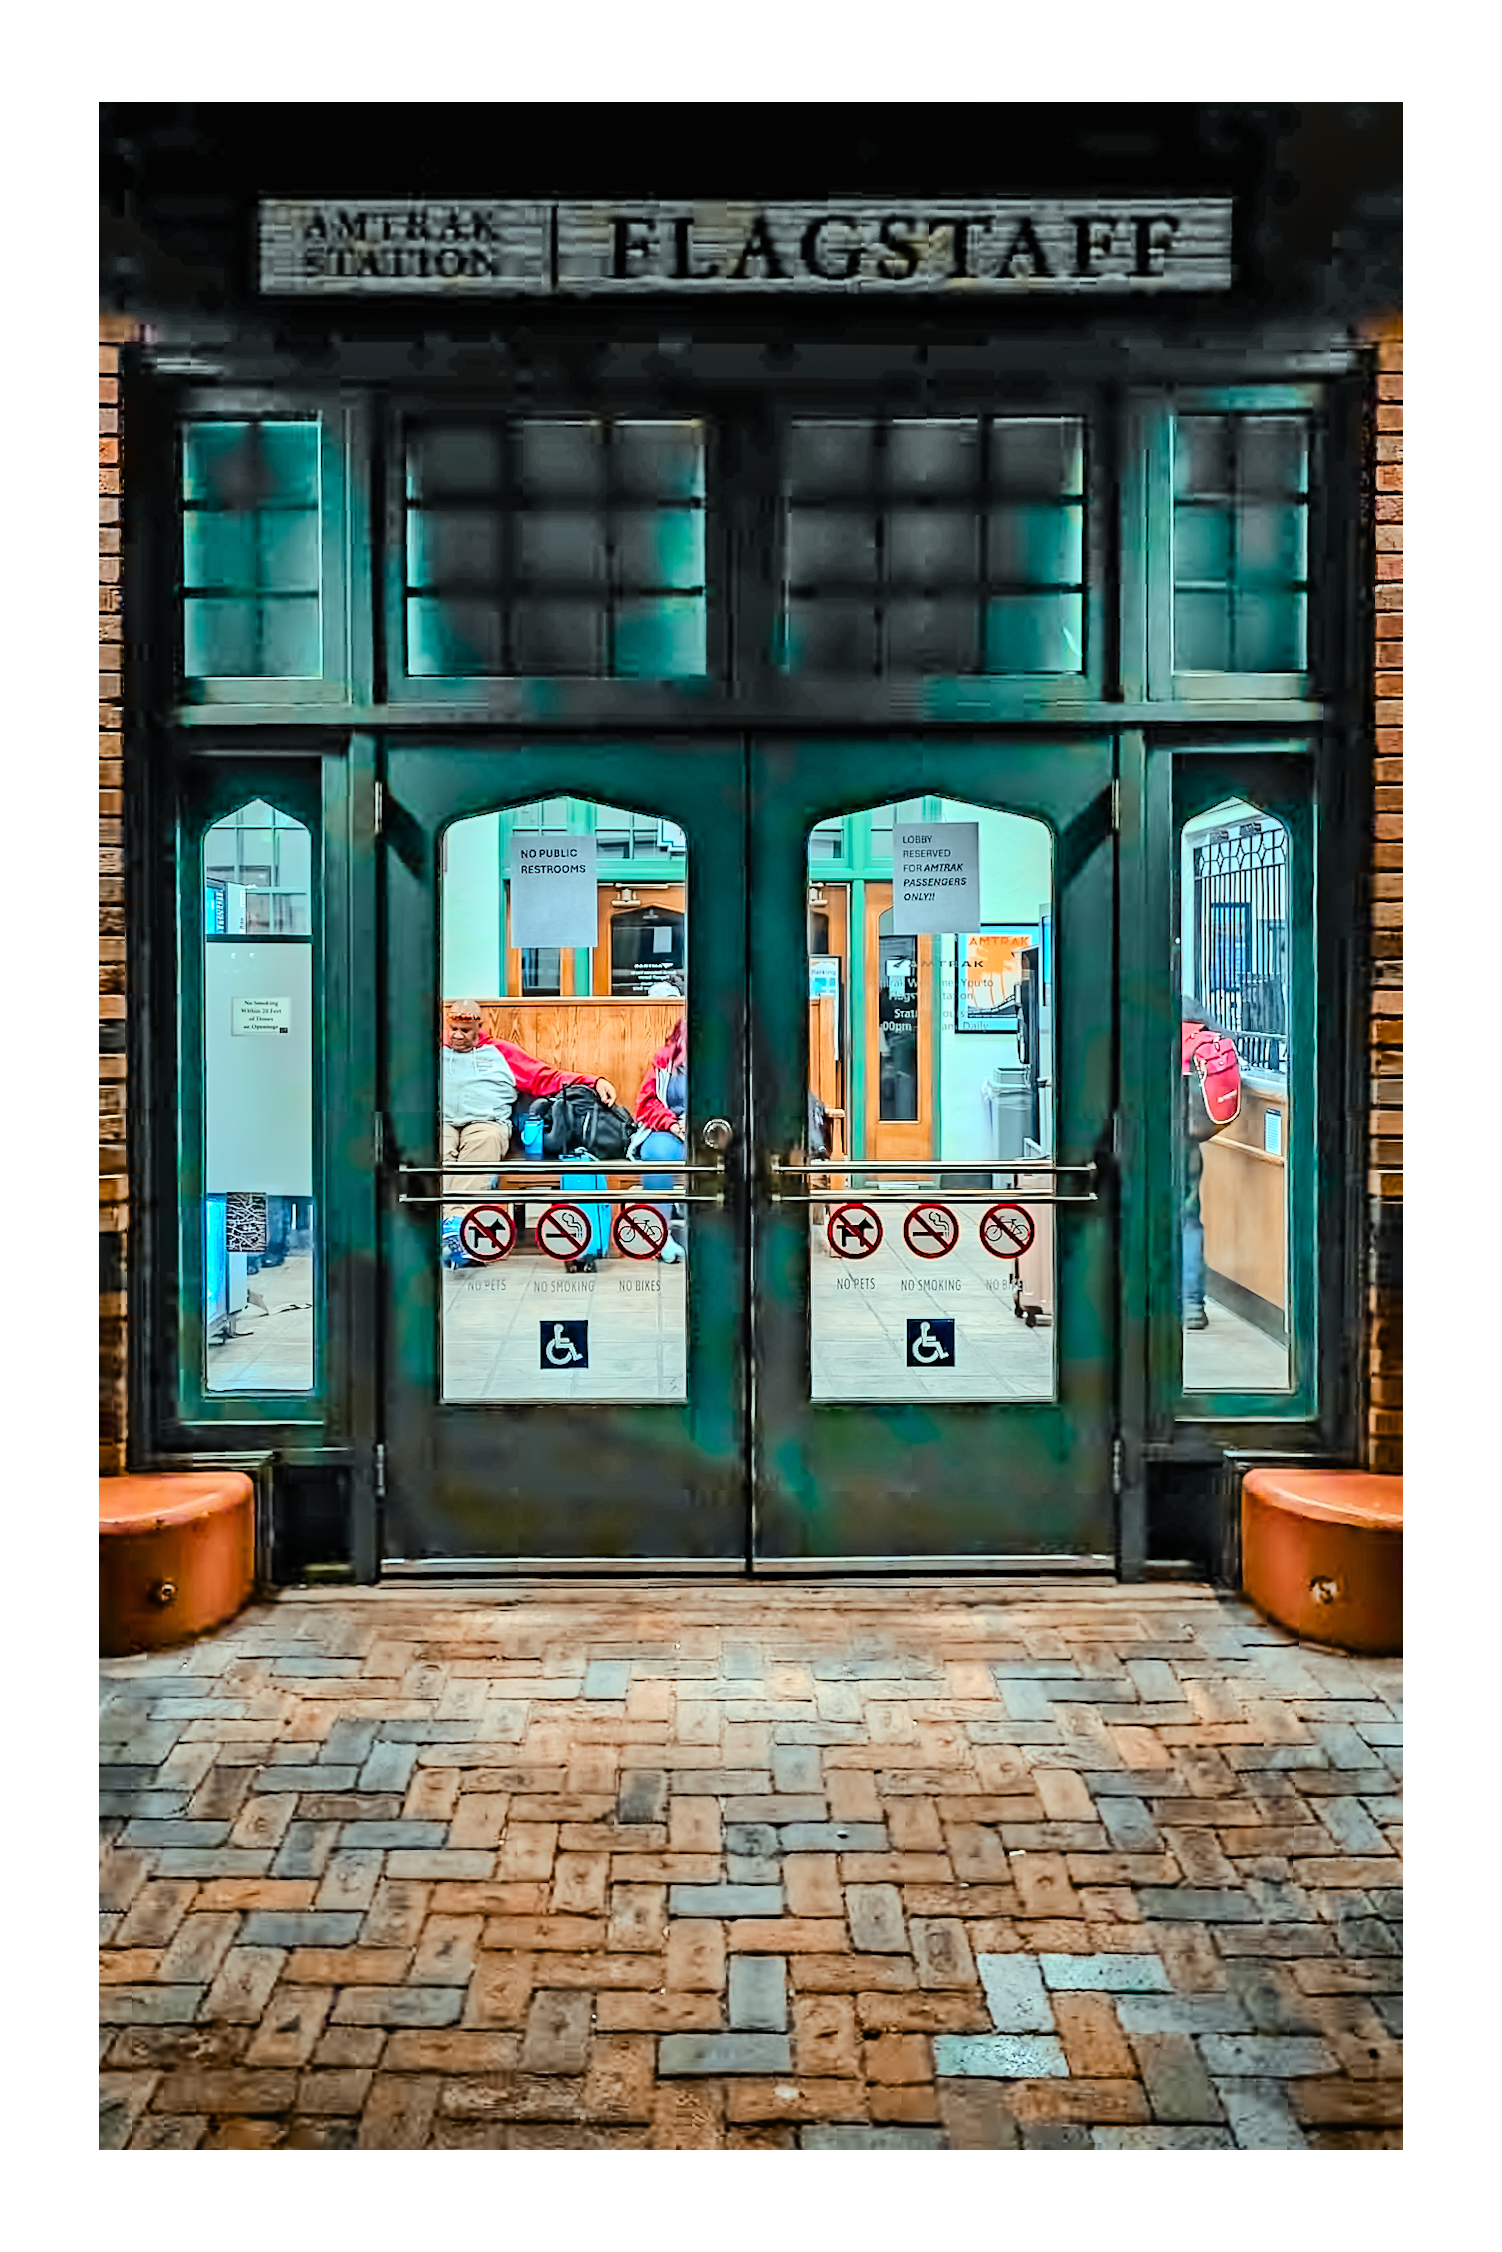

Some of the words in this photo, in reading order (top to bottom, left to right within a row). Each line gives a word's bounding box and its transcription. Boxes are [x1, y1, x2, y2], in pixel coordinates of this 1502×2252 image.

[304, 207, 499, 242] AMTRAK
[607, 215, 1180, 280] FLAGSTAFF
[304, 247, 497, 277] STATION
[902, 835, 933, 844] LOBBY
[520, 849, 537, 858] NO
[539, 848, 578, 858] PUBLIC
[902, 849, 951, 858] RESERVED
[520, 864, 587, 874] RESTROOMS
[902, 864, 923, 873] FOR
[923, 863, 964, 872] AMTRAK
[903, 877, 967, 887] PASSENGERS
[903, 892, 936, 901] ONLY!!
[968, 936, 1030, 946] AMTRAK
[960, 978, 981, 988] You
[983, 979, 994, 988] to
[962, 1021, 989, 1032] Daily
[467, 1280, 482, 1291] NO
[484, 1280, 507, 1291] PETS
[533, 1281, 548, 1293] NO
[550, 1280, 595, 1292] SMOKING
[618, 1280, 633, 1292] NO
[635, 1280, 661, 1292] BIKES
[836, 1278, 851, 1290] NO
[853, 1278, 876, 1290] PETS
[900, 1279, 915, 1291] NO
[917, 1279, 962, 1291] SMOKING
[985, 1279, 1000, 1291] NO
